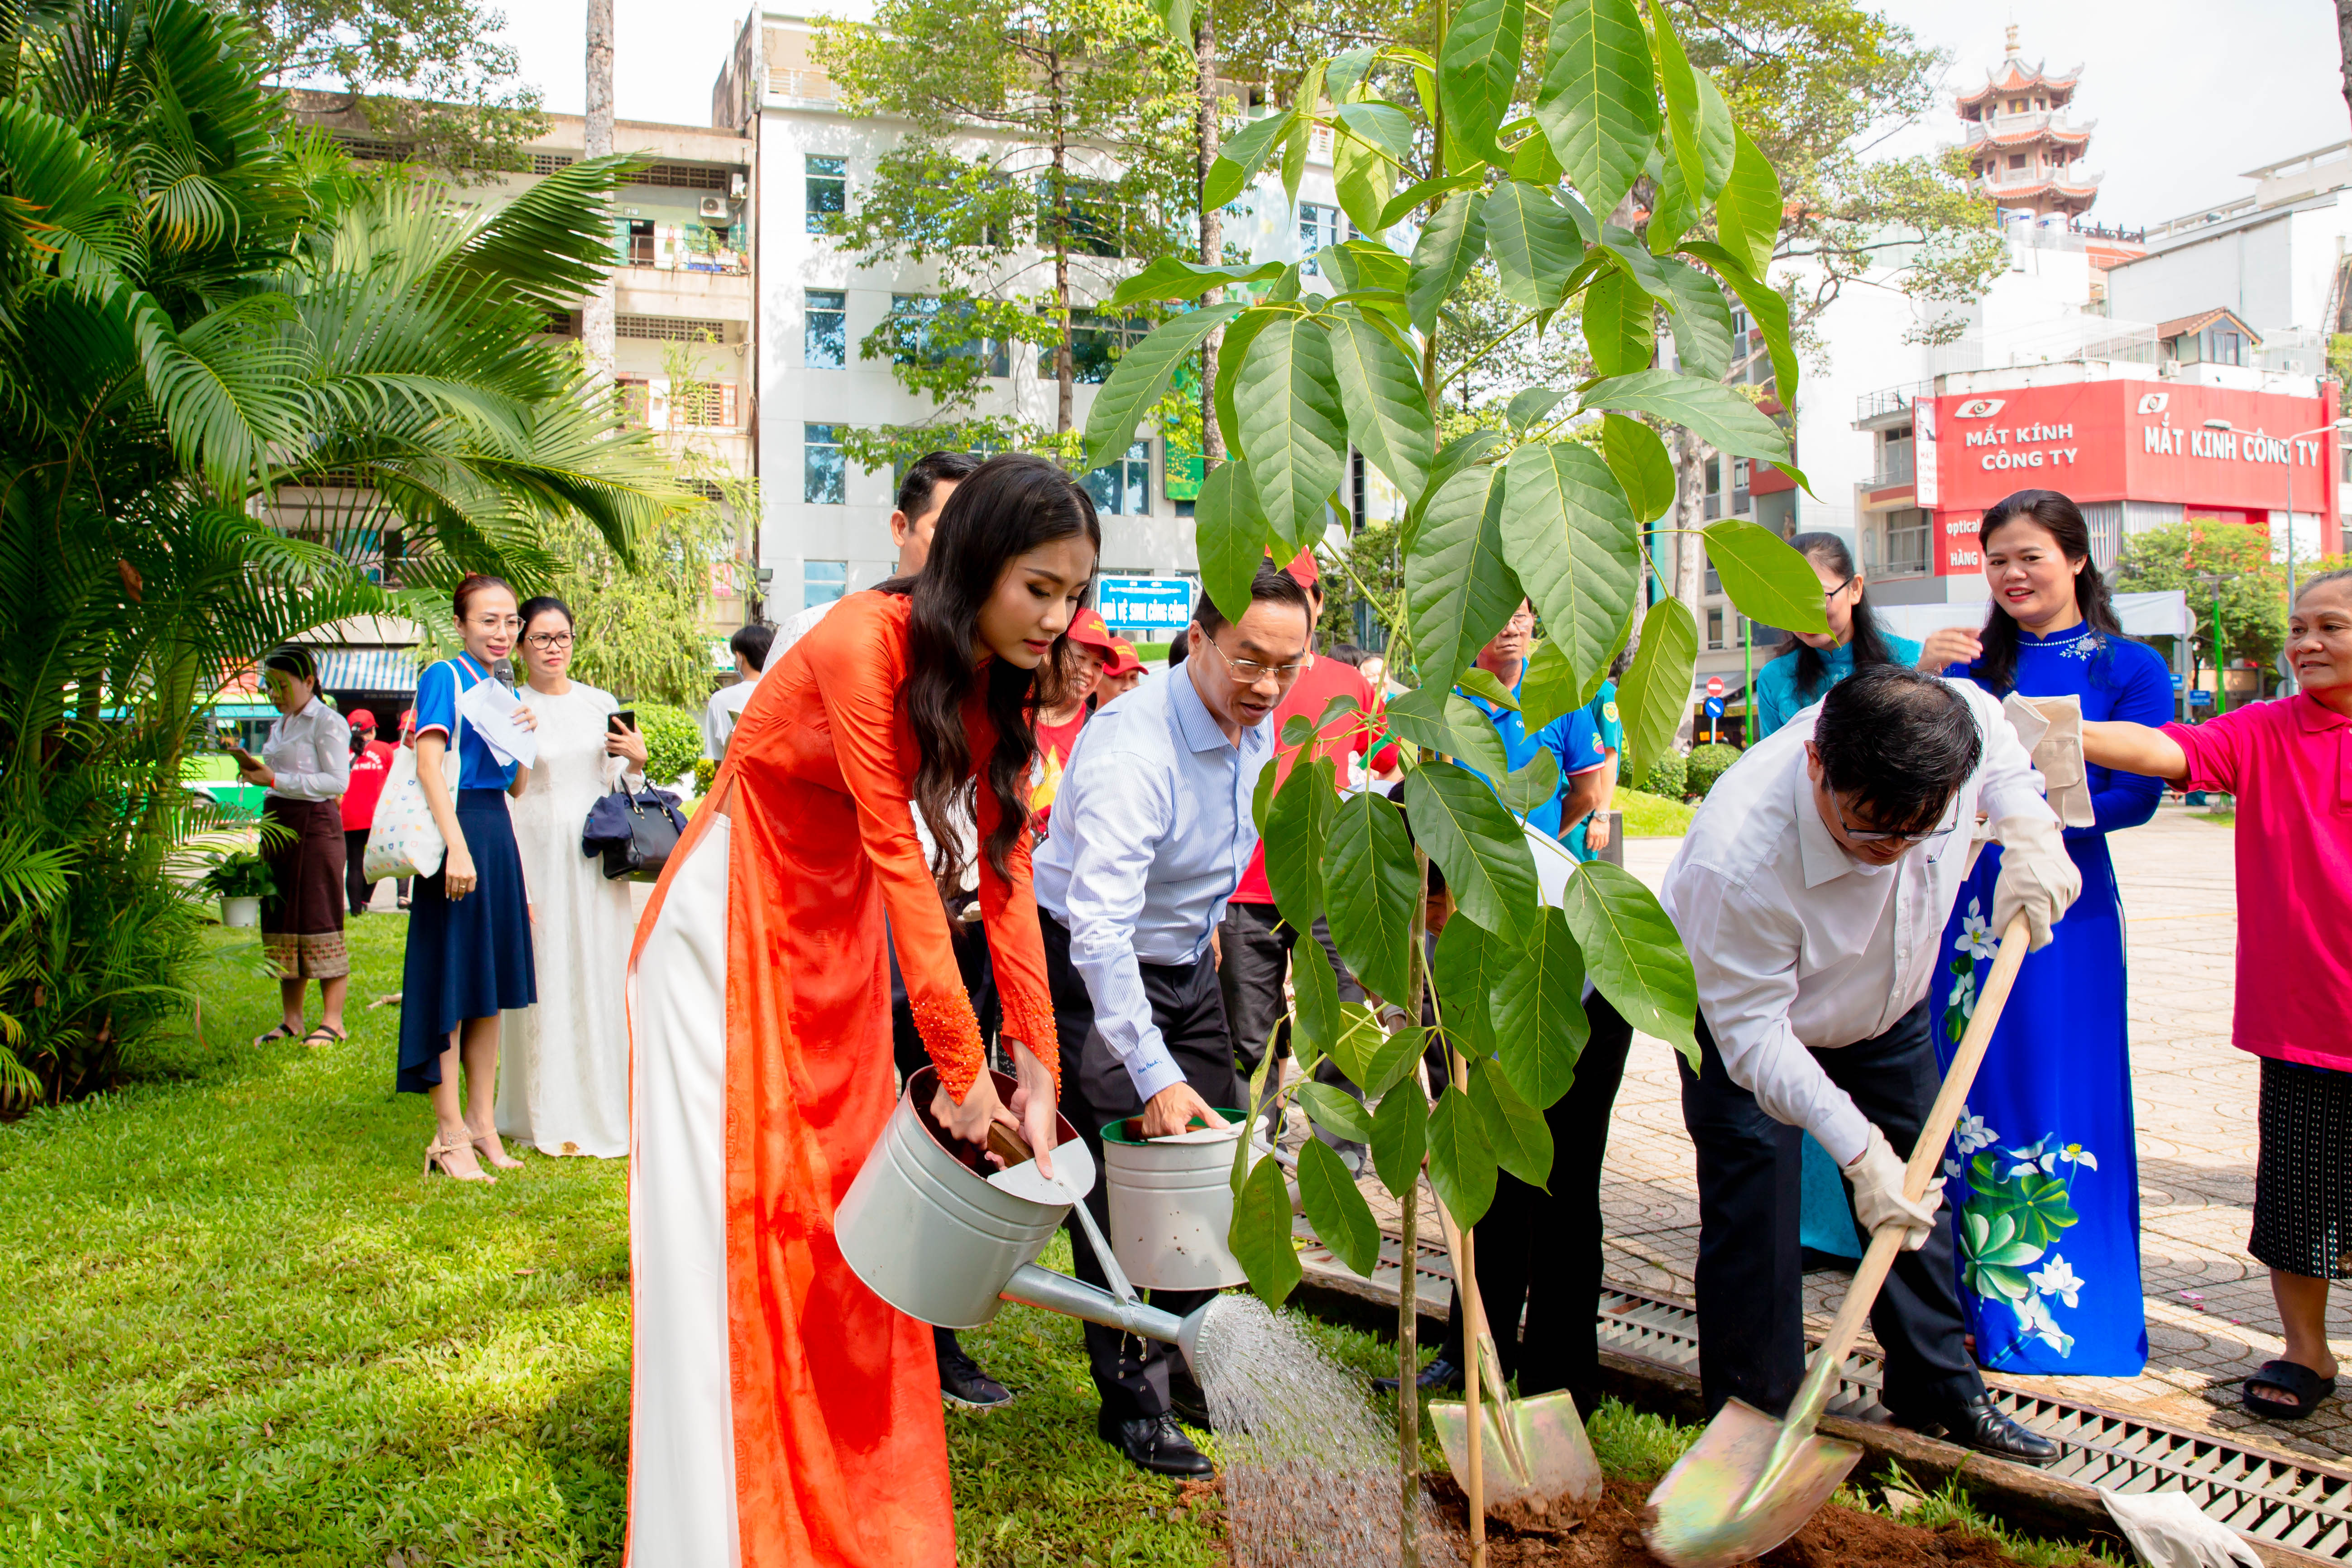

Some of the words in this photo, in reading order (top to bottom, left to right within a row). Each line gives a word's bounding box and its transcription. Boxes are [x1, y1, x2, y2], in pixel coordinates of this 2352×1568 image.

[1966, 424, 2010, 447] MẮT
[2016, 422, 2073, 443] KÍNH
[2144, 412, 2184, 455] MẮT
[2295, 440, 2319, 467] TY
[1982, 449, 2043, 470] CÔNG
[2048, 447, 2078, 465] TY
[1924, 487, 1932, 496] TY
[1946, 518, 1980, 537] optical
[1950, 548, 1978, 566] HÀNG
